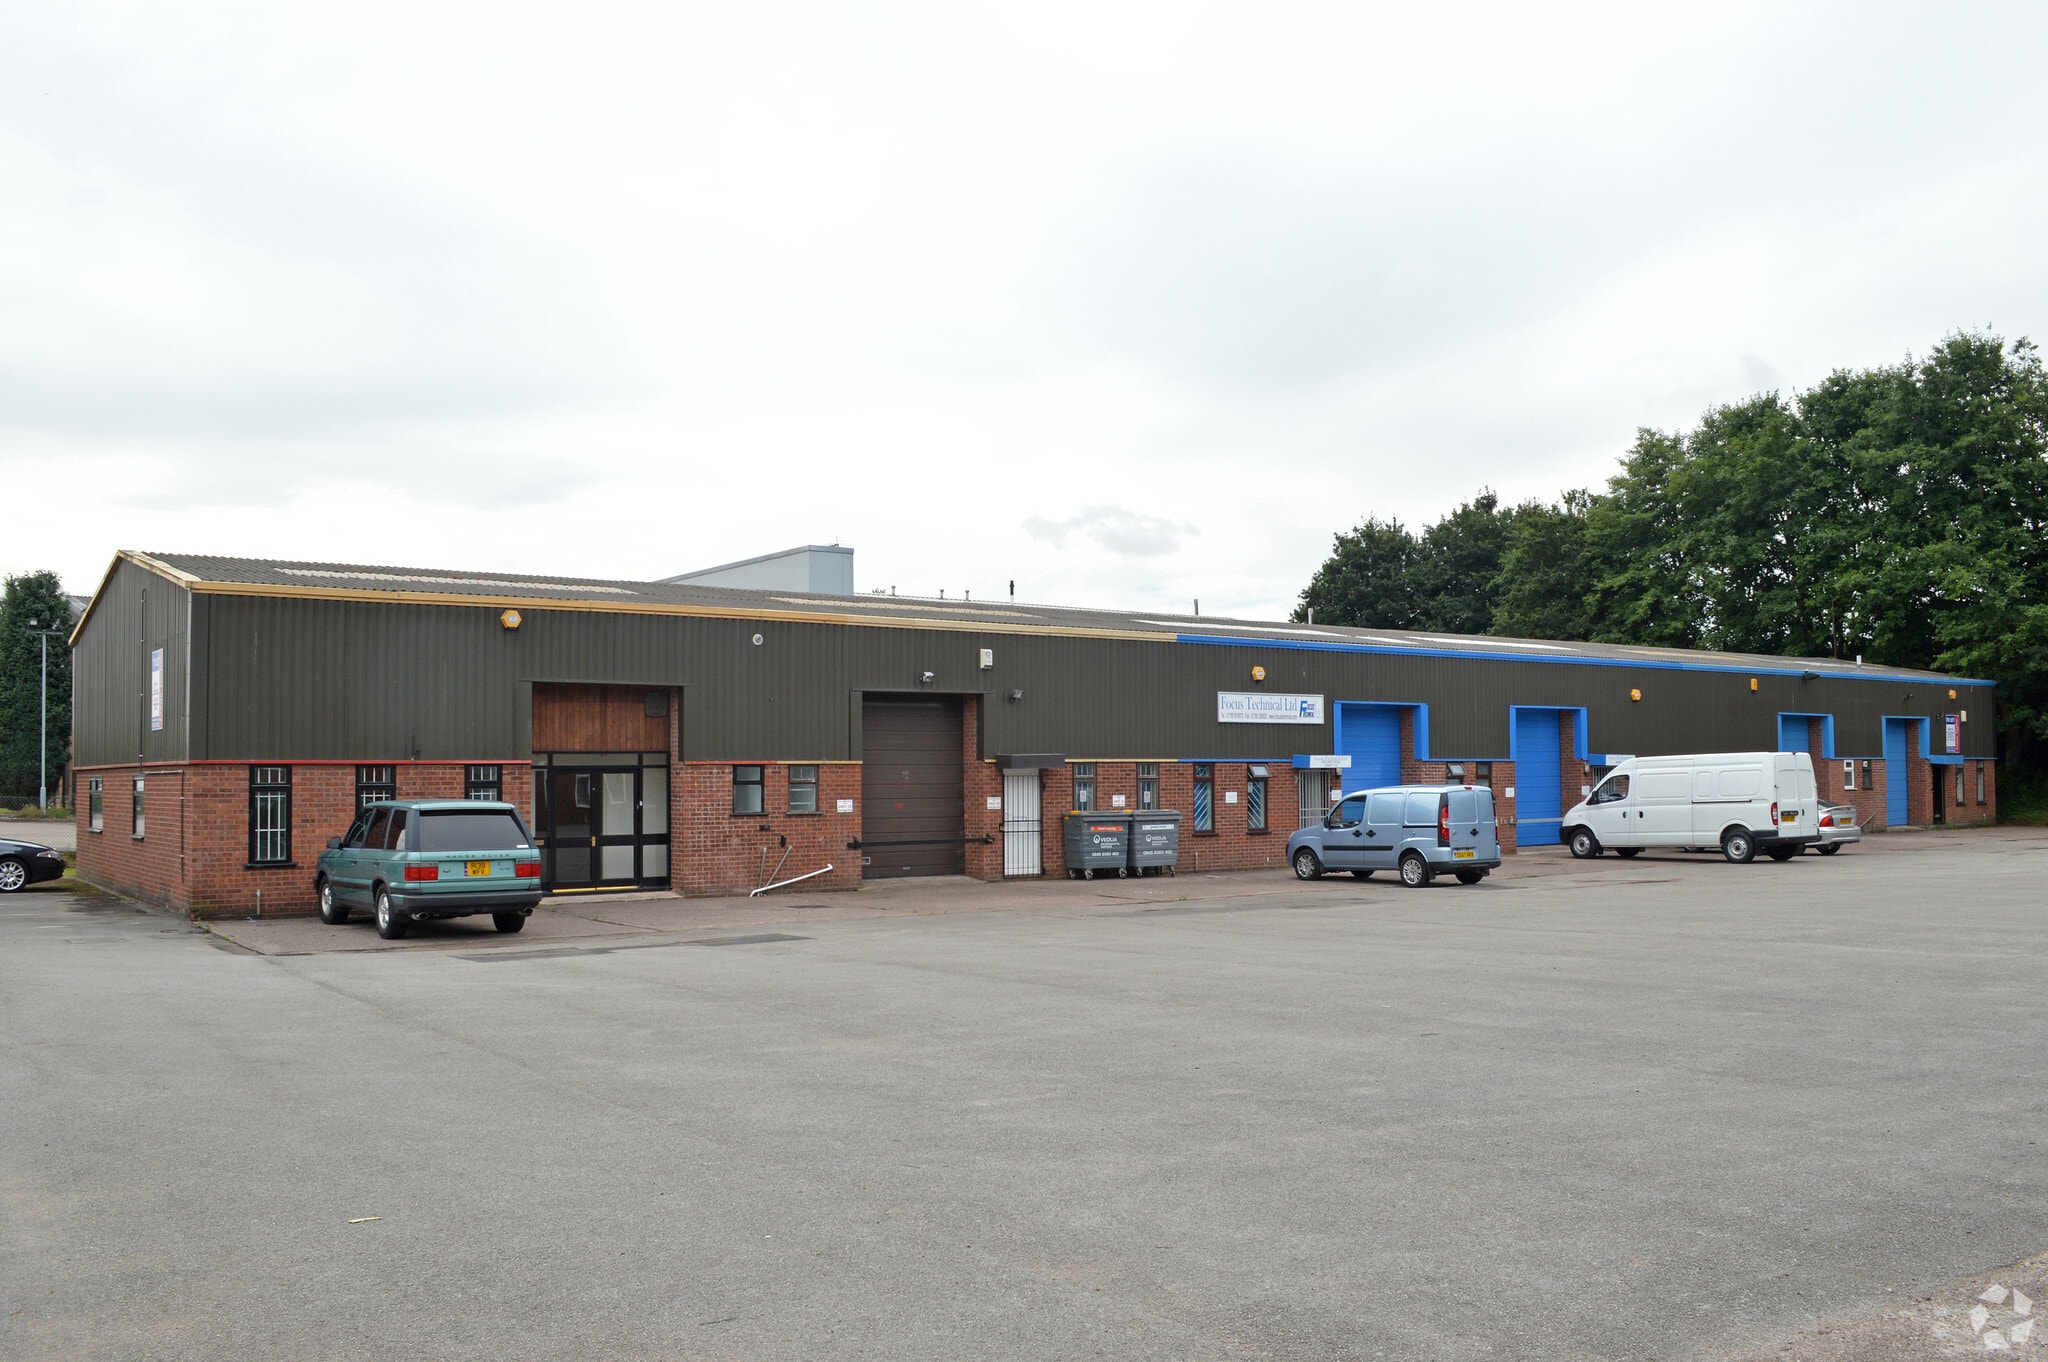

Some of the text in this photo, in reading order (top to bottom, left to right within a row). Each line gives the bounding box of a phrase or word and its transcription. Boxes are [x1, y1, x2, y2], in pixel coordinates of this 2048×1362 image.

[1221, 696, 1297, 711] Focus Technical Ltd
